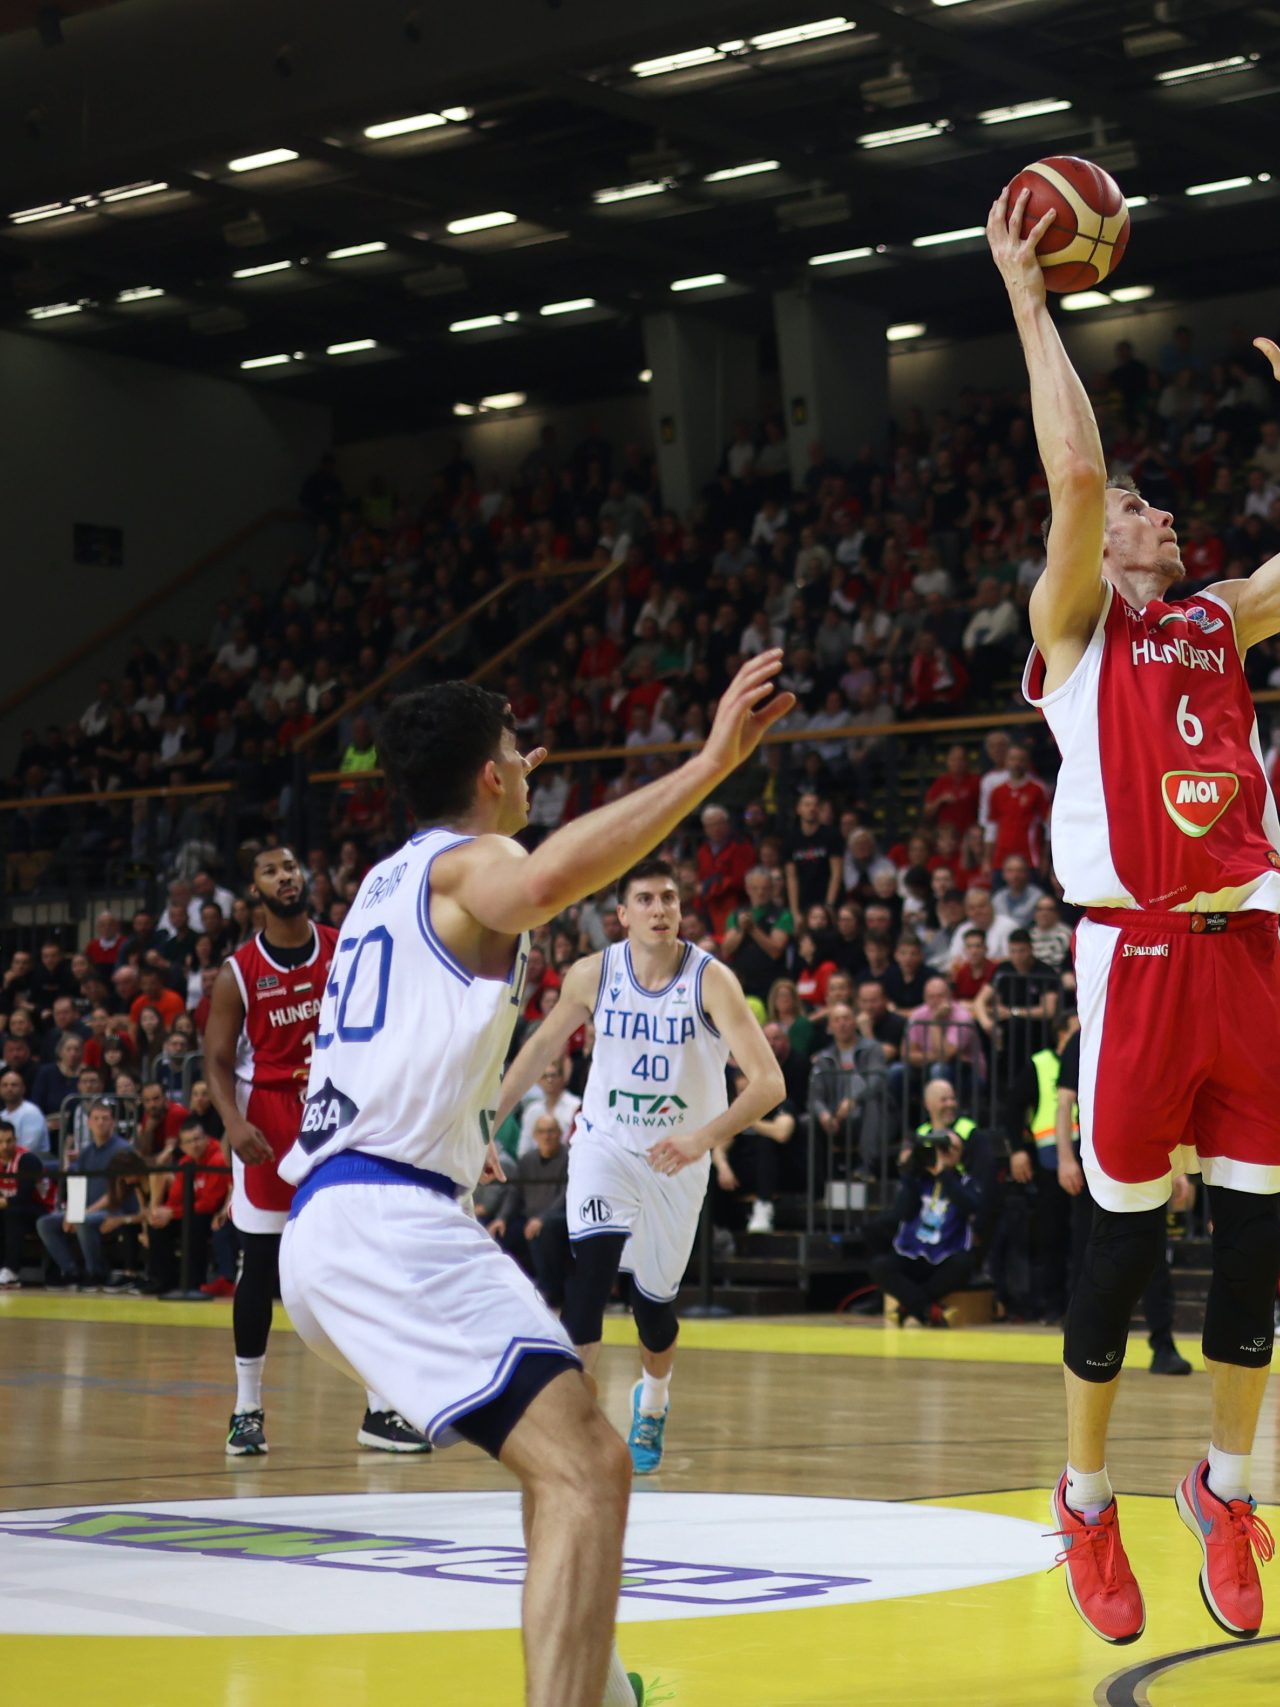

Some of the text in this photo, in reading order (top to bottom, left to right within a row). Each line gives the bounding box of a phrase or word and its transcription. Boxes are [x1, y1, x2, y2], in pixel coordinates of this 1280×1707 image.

[1132, 638, 1225, 674] HUNGARY
[1176, 695, 1204, 746] 6
[1176, 780, 1220, 804] MOL
[1122, 943, 1169, 957] SPALDING
[268, 1000, 322, 1028] HUNGA
[603, 1009, 696, 1045] ITALIA
[631, 1053, 670, 1082] 40
[300, 1098, 341, 1133] BSA
[608, 1088, 689, 1115] ITA
[616, 1112, 685, 1128] AIRWAYS
[581, 1198, 612, 1223] MG
